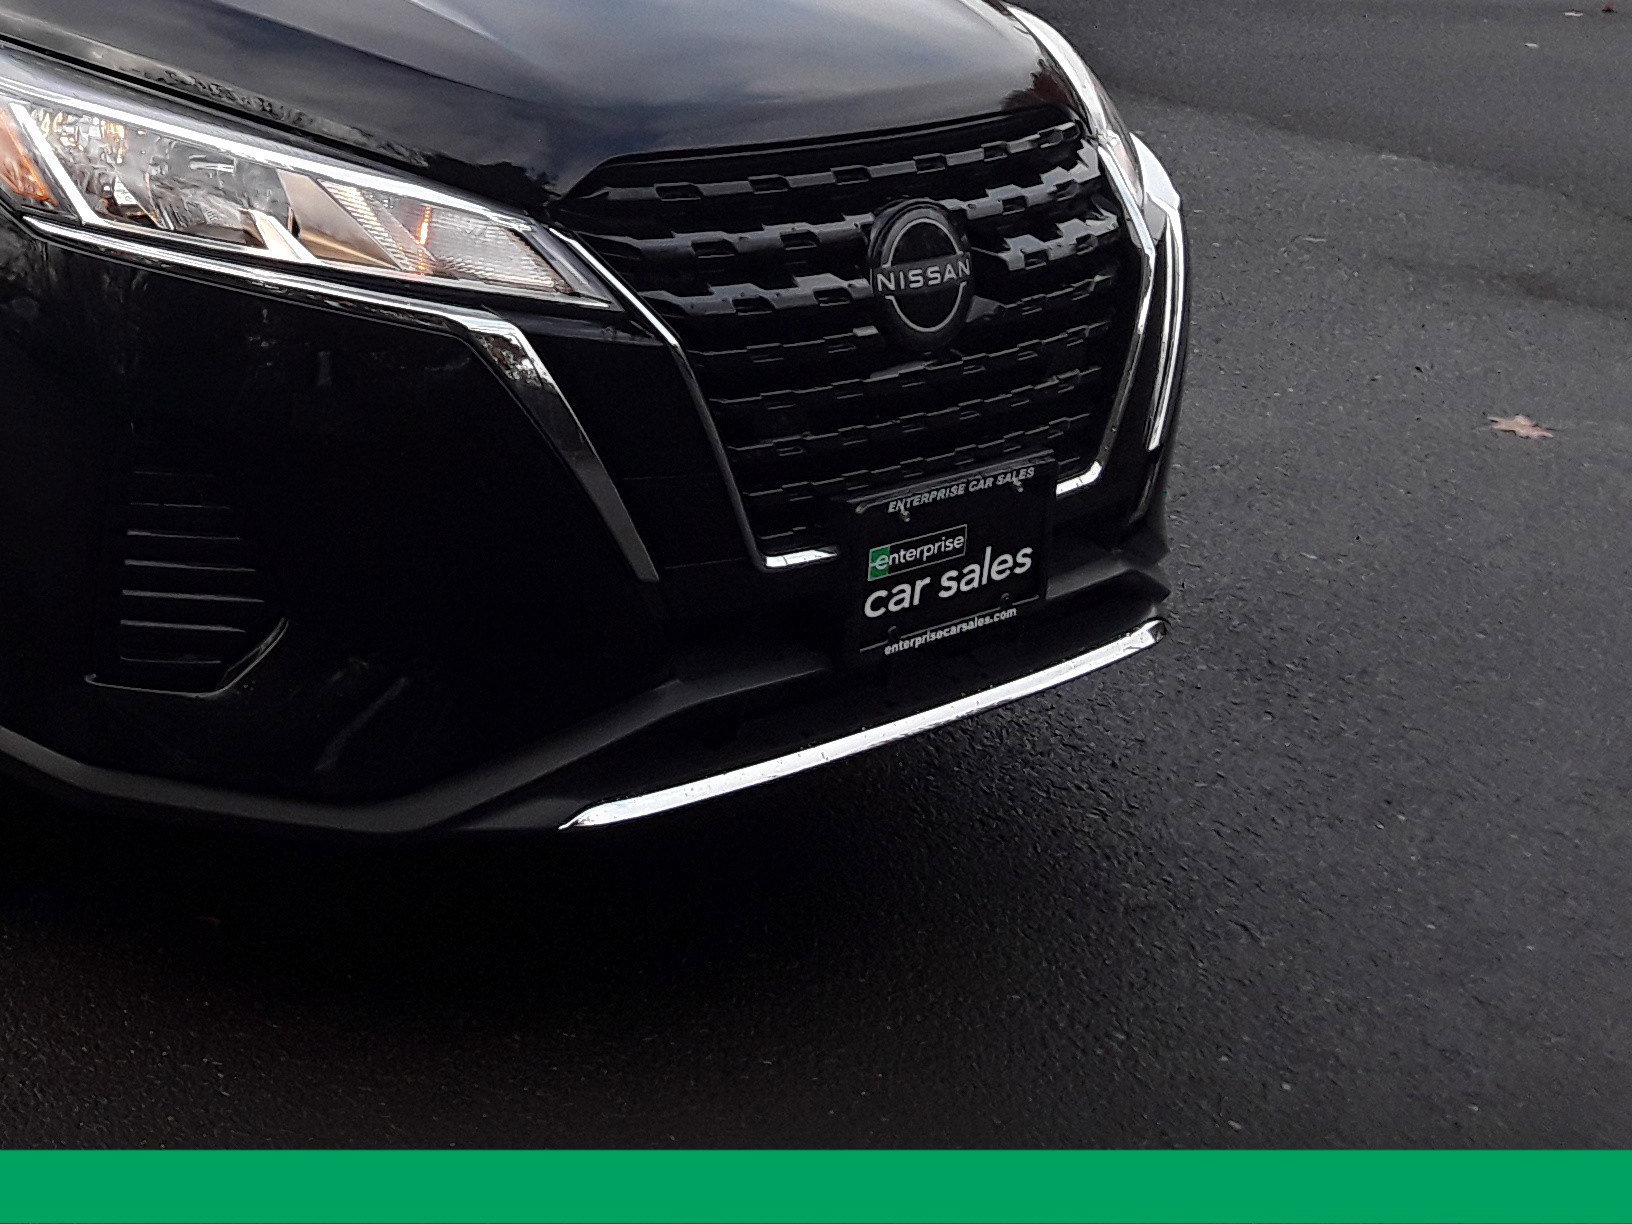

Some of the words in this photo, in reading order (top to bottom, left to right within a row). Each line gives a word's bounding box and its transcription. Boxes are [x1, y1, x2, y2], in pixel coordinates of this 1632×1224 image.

[877, 259, 970, 292] NISSAN
[887, 484, 966, 513] ENTERPRISE
[968, 476, 994, 493] CAR
[996, 467, 1035, 485] SALES
[870, 535, 965, 570] enterprise
[864, 577, 931, 618] car
[938, 546, 1033, 598] sales
[884, 607, 1018, 655] enterprisecarsales.com
